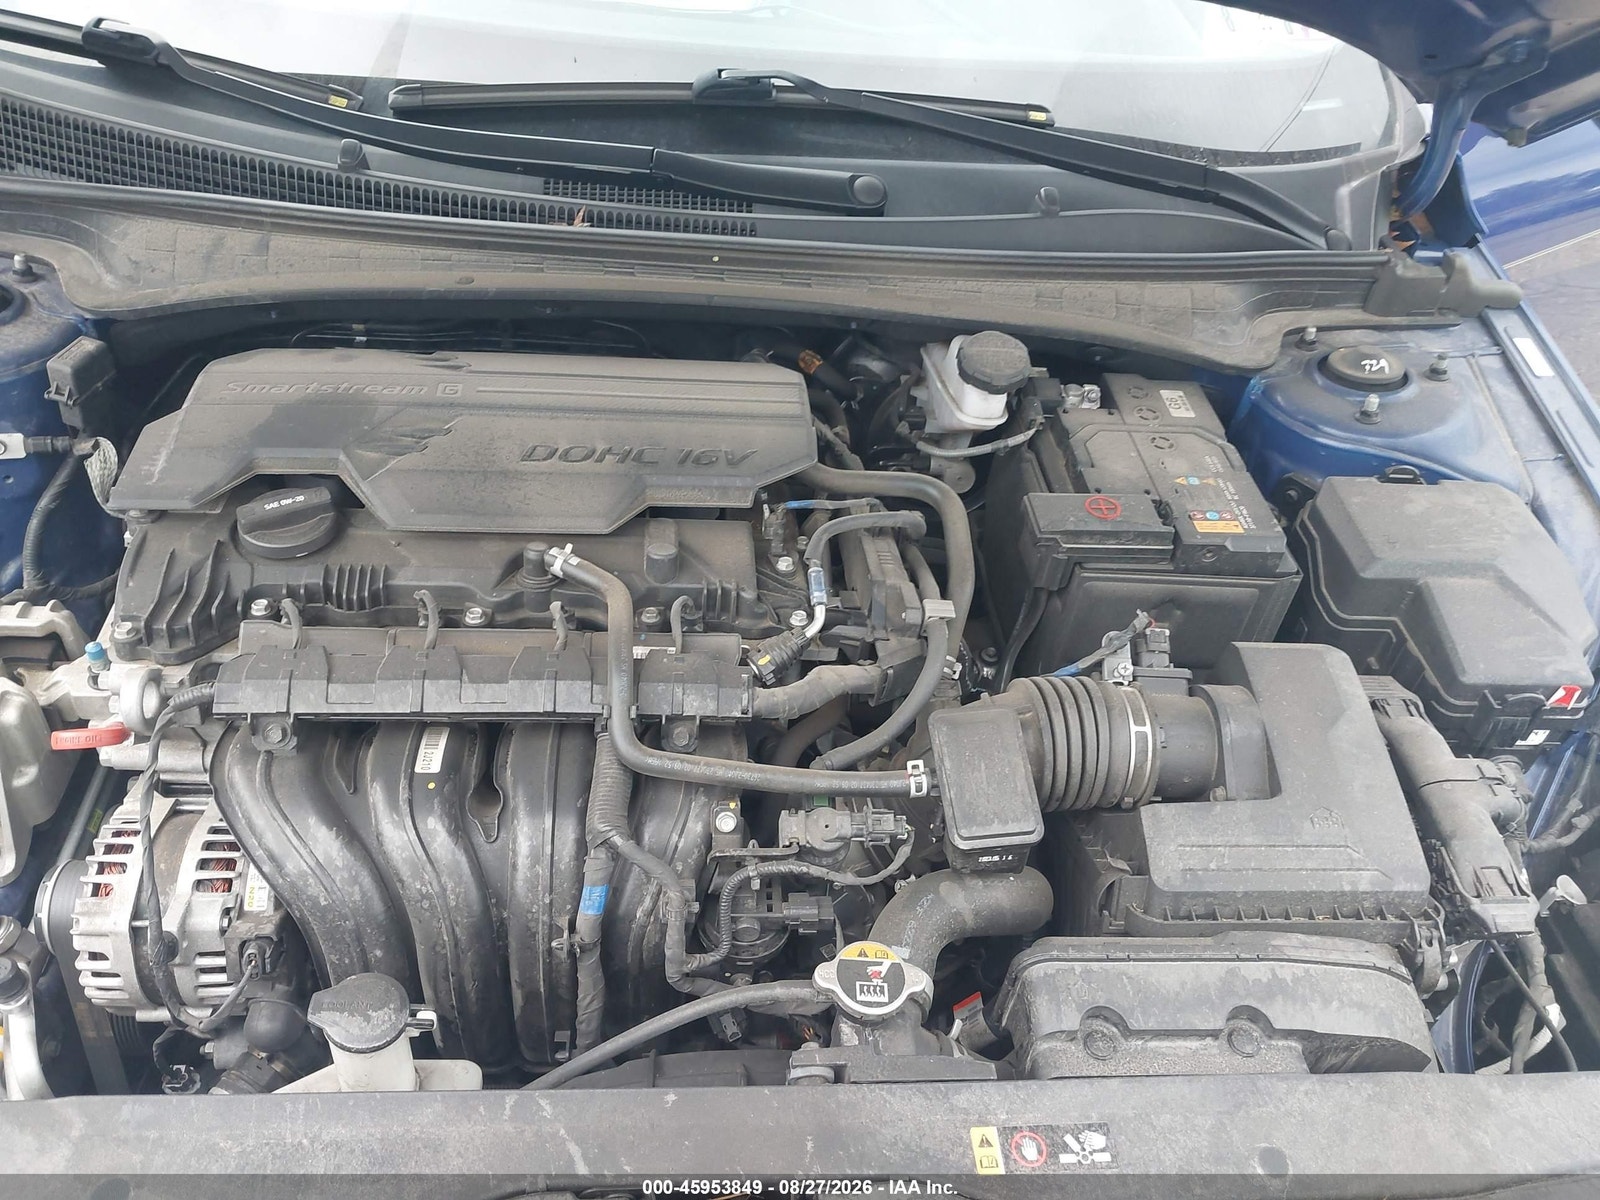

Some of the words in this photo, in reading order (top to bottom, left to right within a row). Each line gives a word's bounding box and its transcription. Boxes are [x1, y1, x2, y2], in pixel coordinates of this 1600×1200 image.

[221, 382, 428, 395] Smartstream
[518, 444, 666, 464] DOHC
[676, 448, 759, 466] 16V
[264, 500, 280, 510] SAE
[280, 495, 305, 506] 0W-20
[321, 1000, 375, 1010] COOLANT
